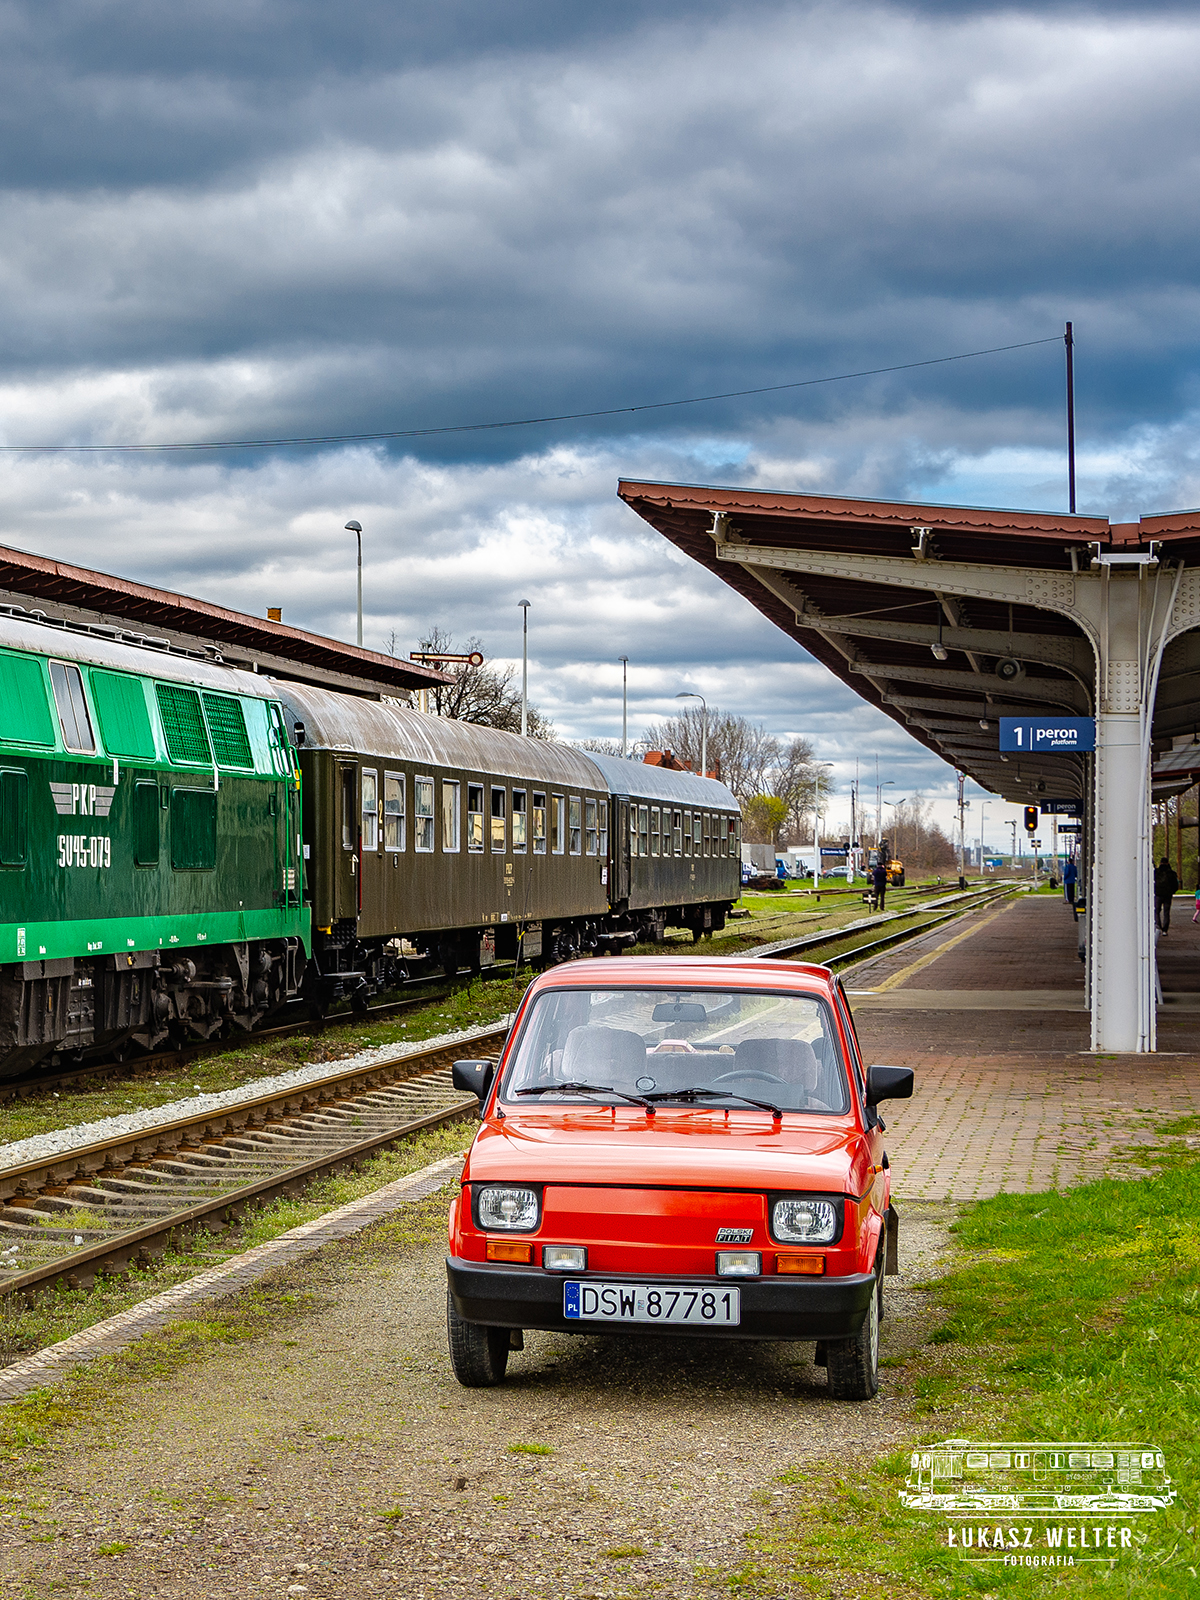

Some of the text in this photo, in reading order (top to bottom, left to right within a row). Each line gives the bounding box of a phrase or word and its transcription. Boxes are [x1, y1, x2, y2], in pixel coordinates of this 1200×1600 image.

[1013, 726, 1078, 746] 1 peron
[72, 783, 96, 816] PKP
[1046, 803, 1052, 813] 1
[378, 799, 383, 824] 2
[58, 834, 111, 868] SU45-079
[718, 1234, 749, 1242] FIAT
[567, 1303, 578, 1312] PL
[582, 1287, 731, 1320] DSW 87781
